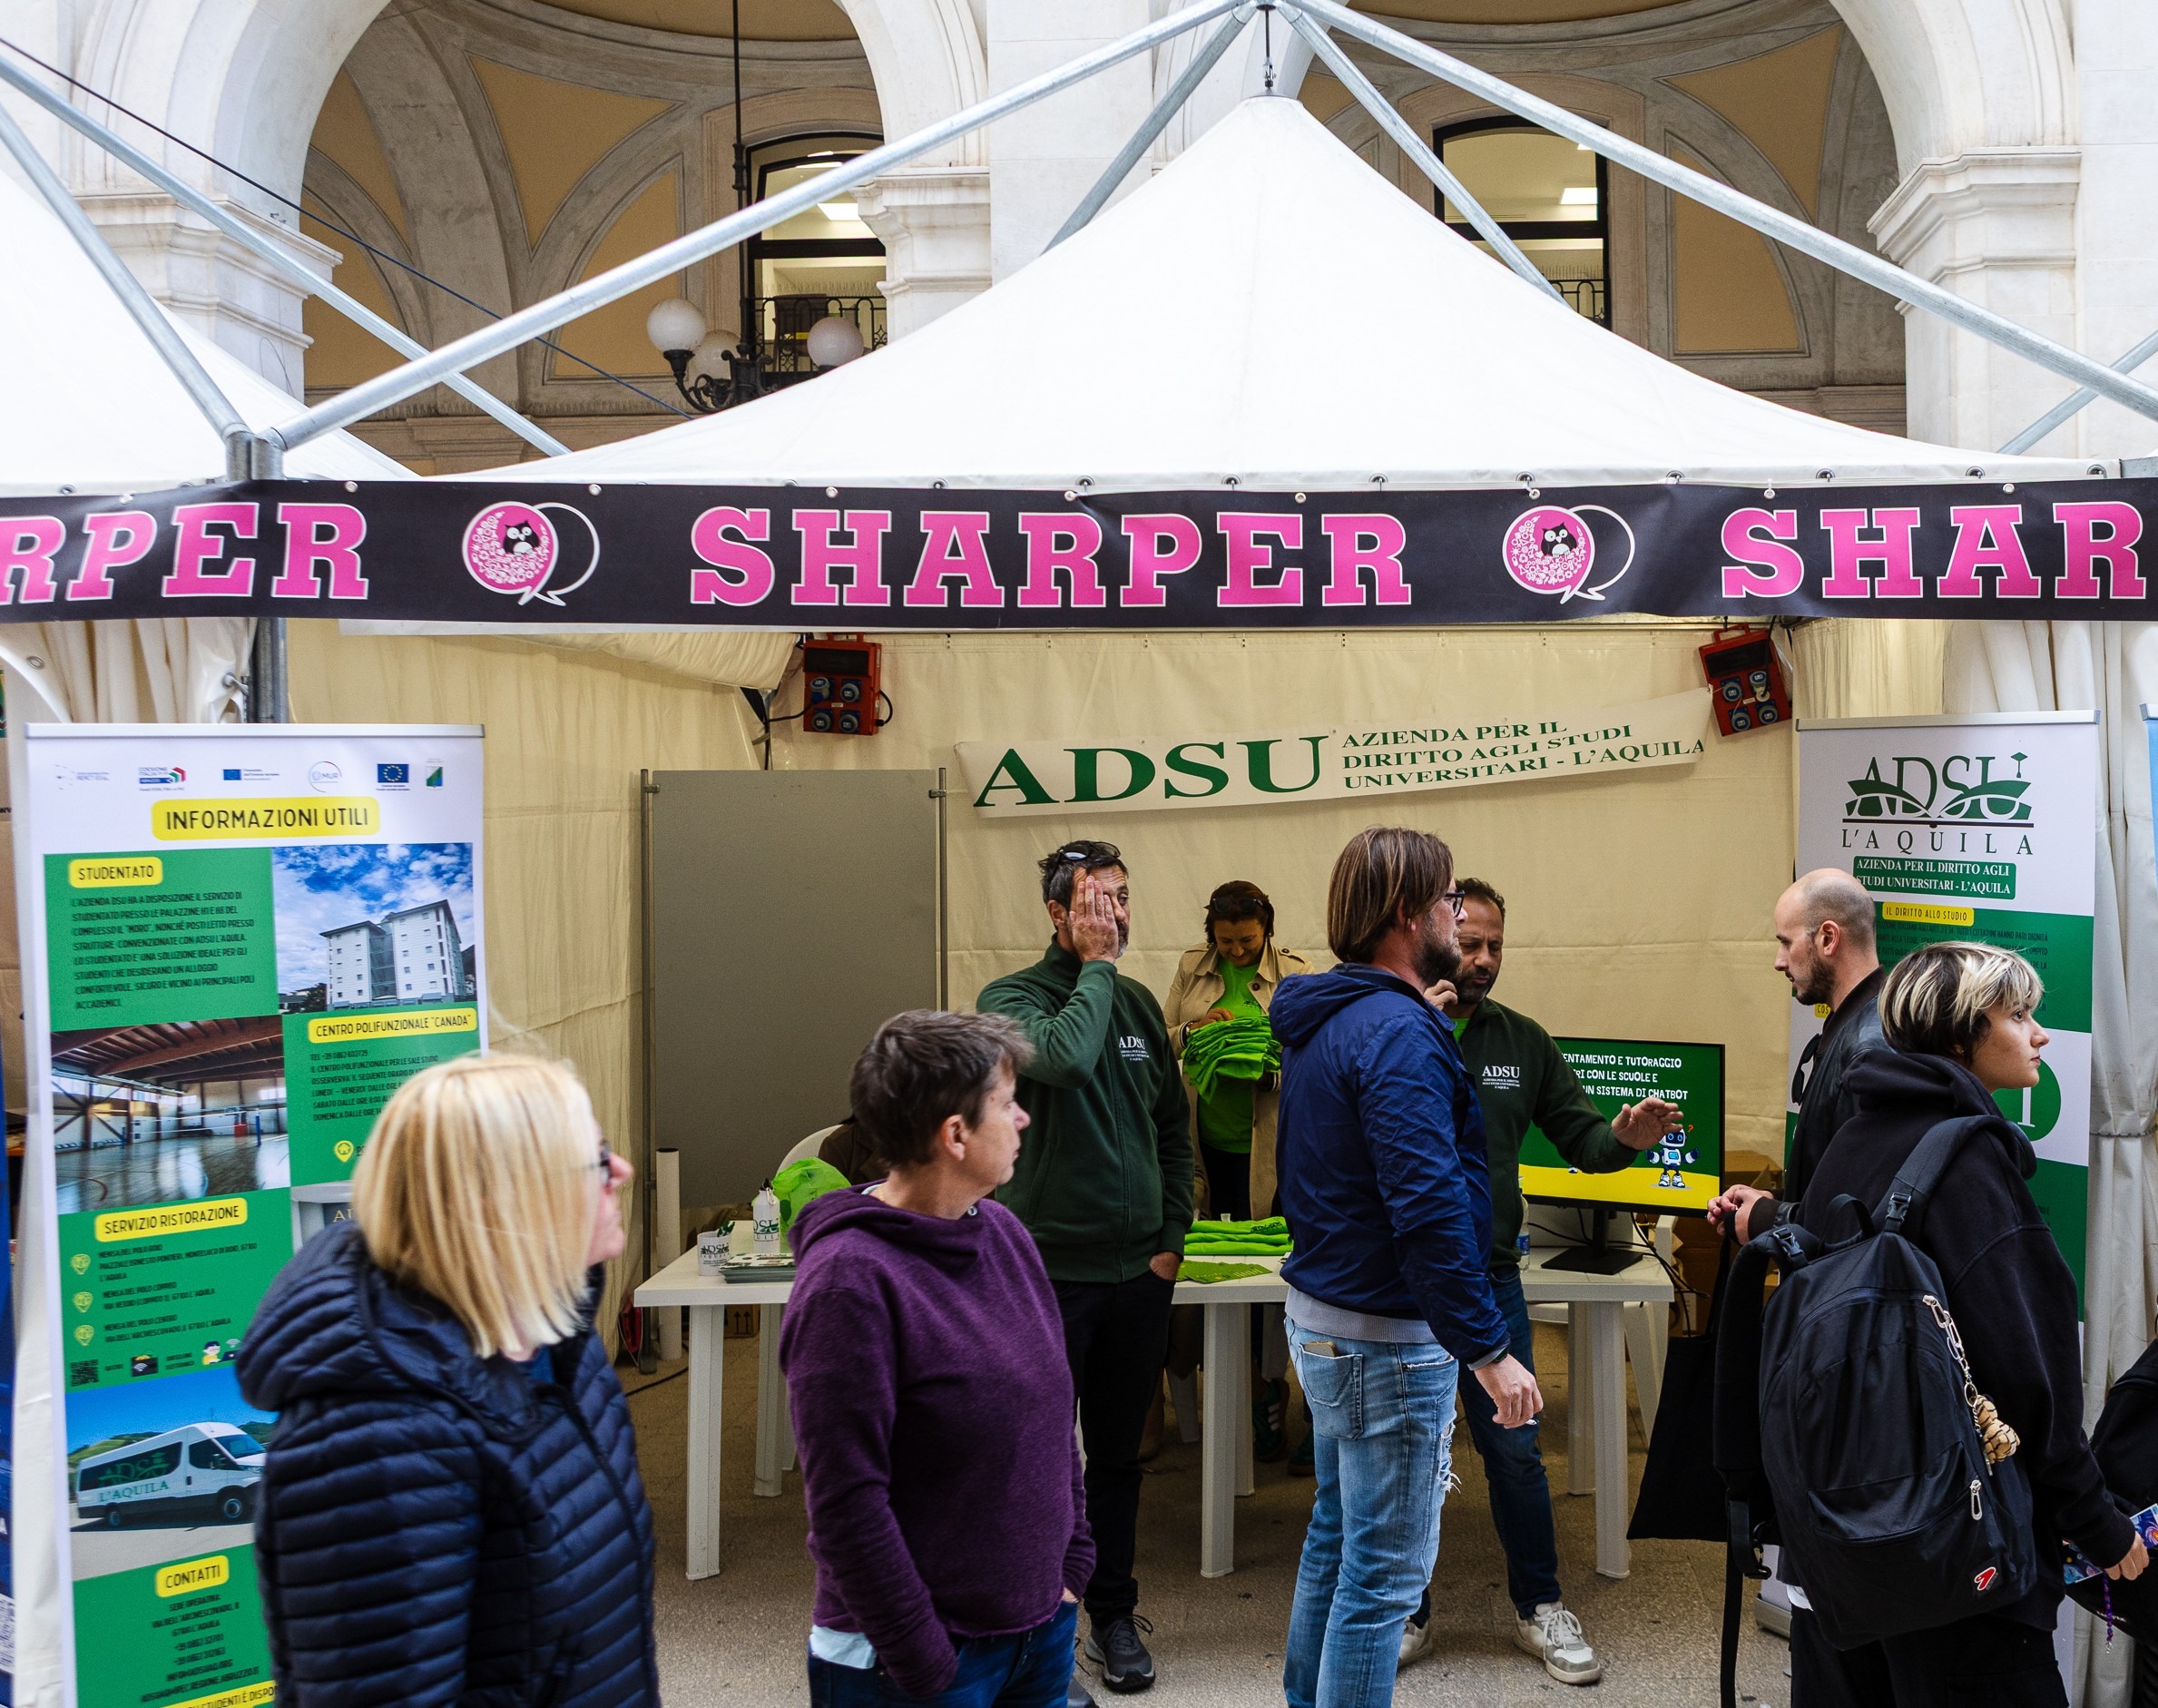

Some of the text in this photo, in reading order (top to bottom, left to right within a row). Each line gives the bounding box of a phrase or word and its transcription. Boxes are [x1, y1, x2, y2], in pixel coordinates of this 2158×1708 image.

[690, 506, 1413, 608] SHARPER
[1721, 501, 2146, 601] SHAR
[1341, 721, 1568, 748] AZIENDA PER IL
[1343, 724, 1633, 770] DIRITTO AGLI STUDI
[973, 735, 1329, 808] ADSU
[1344, 757, 1550, 790] UNIVERSITARI
[166, 808, 368, 829] INFORMAZIONI UTILI
[78, 865, 154, 880] STUDENTATO
[1857, 859, 2010, 877] AZIENDA PER IL DIRITTO AGLI
[1887, 877, 1954, 890] UNIVERSITARI
[146, 894, 194, 903] DISPOSIZIONE
[203, 892, 233, 900] SERVIZIO
[73, 912, 119, 921] STUDENTATO
[121, 910, 149, 919] PRESSO
[161, 908, 200, 918] PALAZZINE
[1886, 907, 1967, 921] IL DIRITTO ALLO STUDIO
[74, 926, 116, 936] COMPLESSO
[187, 921, 206, 930] POSTI
[207, 920, 227, 929] LETTO
[228, 919, 254, 928] PRESSO
[1974, 928, 1996, 937] CITTADINI
[1996, 930, 2014, 938] HANNO
[2015, 932, 2027, 940] PARI
[74, 936, 214, 950] STRUTTURE CONVENZIONATE CON ADSU
[85, 954, 132, 965] STUDENTATO
[141, 953, 156, 961] UNA
[158, 950, 197, 960] SOLUZIONE
[199, 949, 221, 957] IDEALE
[223, 948, 236, 957] PER
[237, 947, 247, 956] GLI
[74, 964, 218, 979] STUDENTI CHE DESIDERANO UN ALLOGGIO
[136, 981, 162, 990] SICURO
[169, 979, 192, 988] VICINO
[240, 976, 254, 984] POLI
[316, 1023, 353, 1037] CENTRO
[357, 1016, 429, 1034] POLIFUNZIONALE
[318, 1064, 340, 1073] CENTRO
[341, 1060, 388, 1070] POLIFUNZIONALE
[407, 1056, 420, 1065] SALE
[1617, 1055, 1623, 1065] E
[1625, 1056, 1682, 1068] TUTORAGGIO
[358, 1072, 387, 1080] SEGUENTE
[1482, 1065, 1520, 1079] ADSU
[1586, 1069, 1658, 1083] CON LE SCUOLE E
[1596, 1085, 1633, 1097] SISTEMA
[1635, 1088, 1646, 1097] DI
[1648, 1089, 1688, 1100] CHATBOT
[313, 1100, 336, 1109] SABATO
[338, 1098, 355, 1106] DALLE
[313, 1112, 343, 1121] DOMENICA
[345, 1110, 362, 1118] DALLE
[104, 1205, 240, 1234] SERVIZIO RISTORAZIONE
[165, 1565, 221, 1588] CONTATTI
